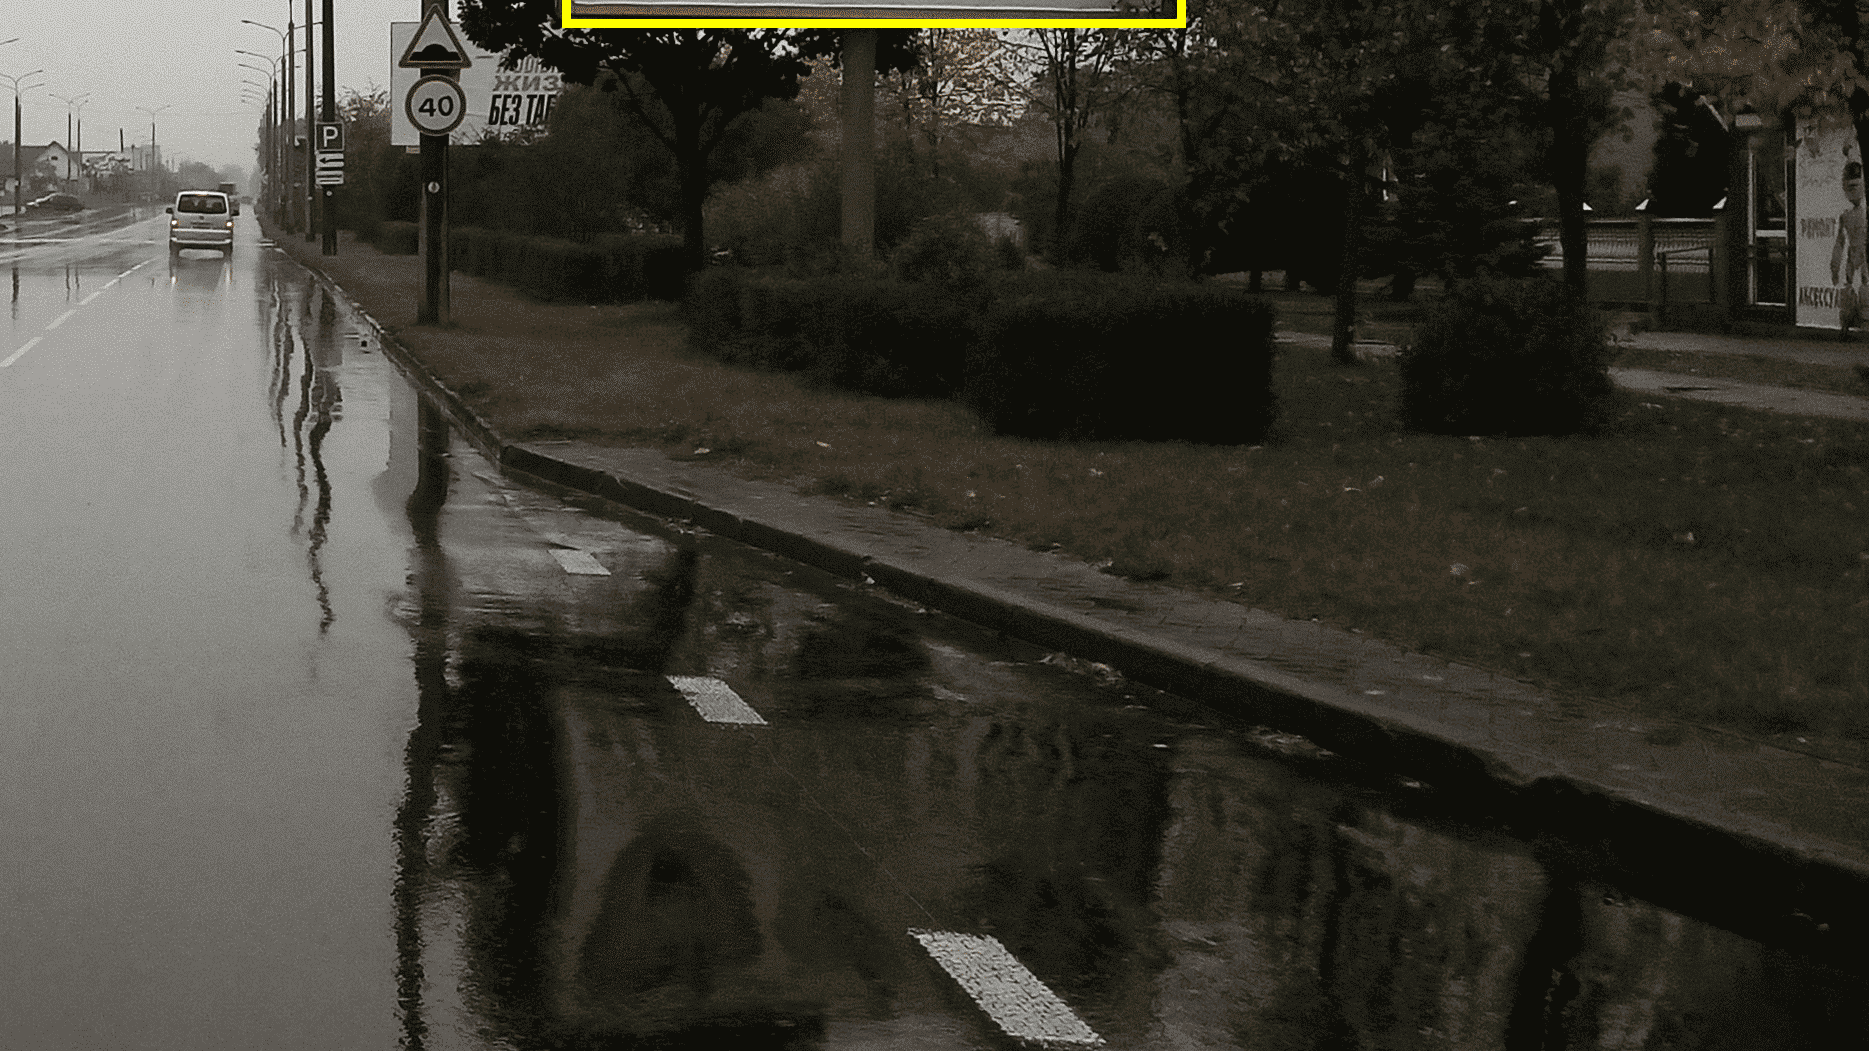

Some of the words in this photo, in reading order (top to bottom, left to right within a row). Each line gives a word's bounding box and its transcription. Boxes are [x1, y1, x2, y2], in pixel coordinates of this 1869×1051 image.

[493, 75, 561, 91] ЖИЗ
[418, 95, 453, 117] 40
[488, 94, 522, 125] БЕЗ
[323, 126, 338, 147] P
